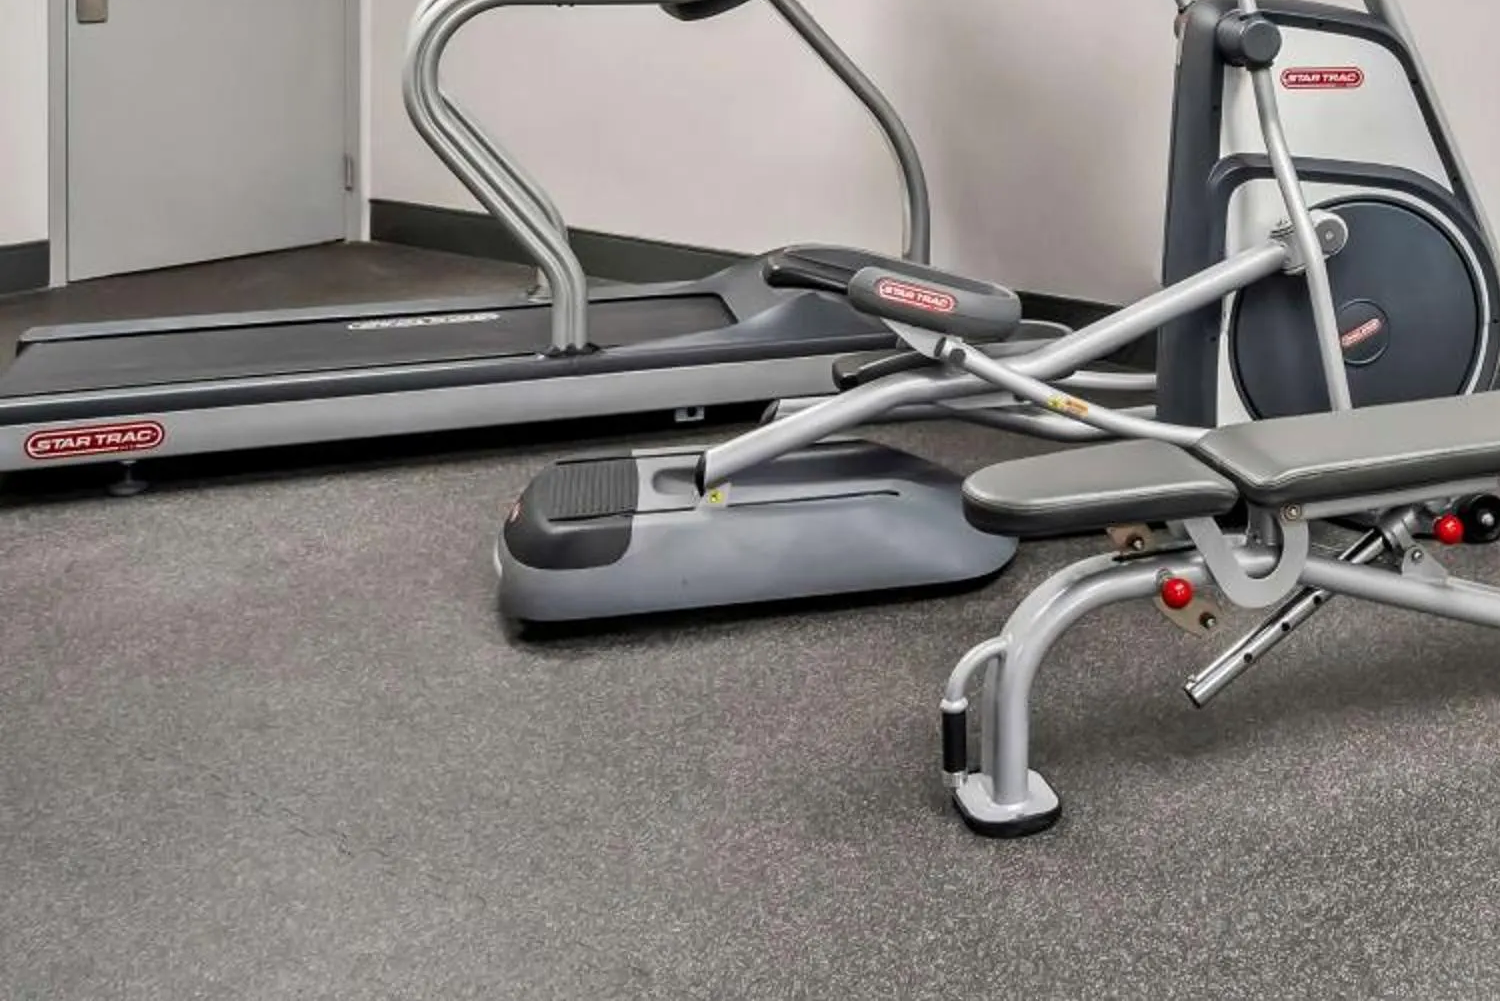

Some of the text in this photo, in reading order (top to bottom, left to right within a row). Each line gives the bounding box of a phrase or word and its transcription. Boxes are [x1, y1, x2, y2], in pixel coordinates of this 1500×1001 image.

[1288, 72, 1358, 82] STAR TRAC
[884, 285, 949, 308] STAR TRAC
[36, 430, 152, 451] STAR TRAC
